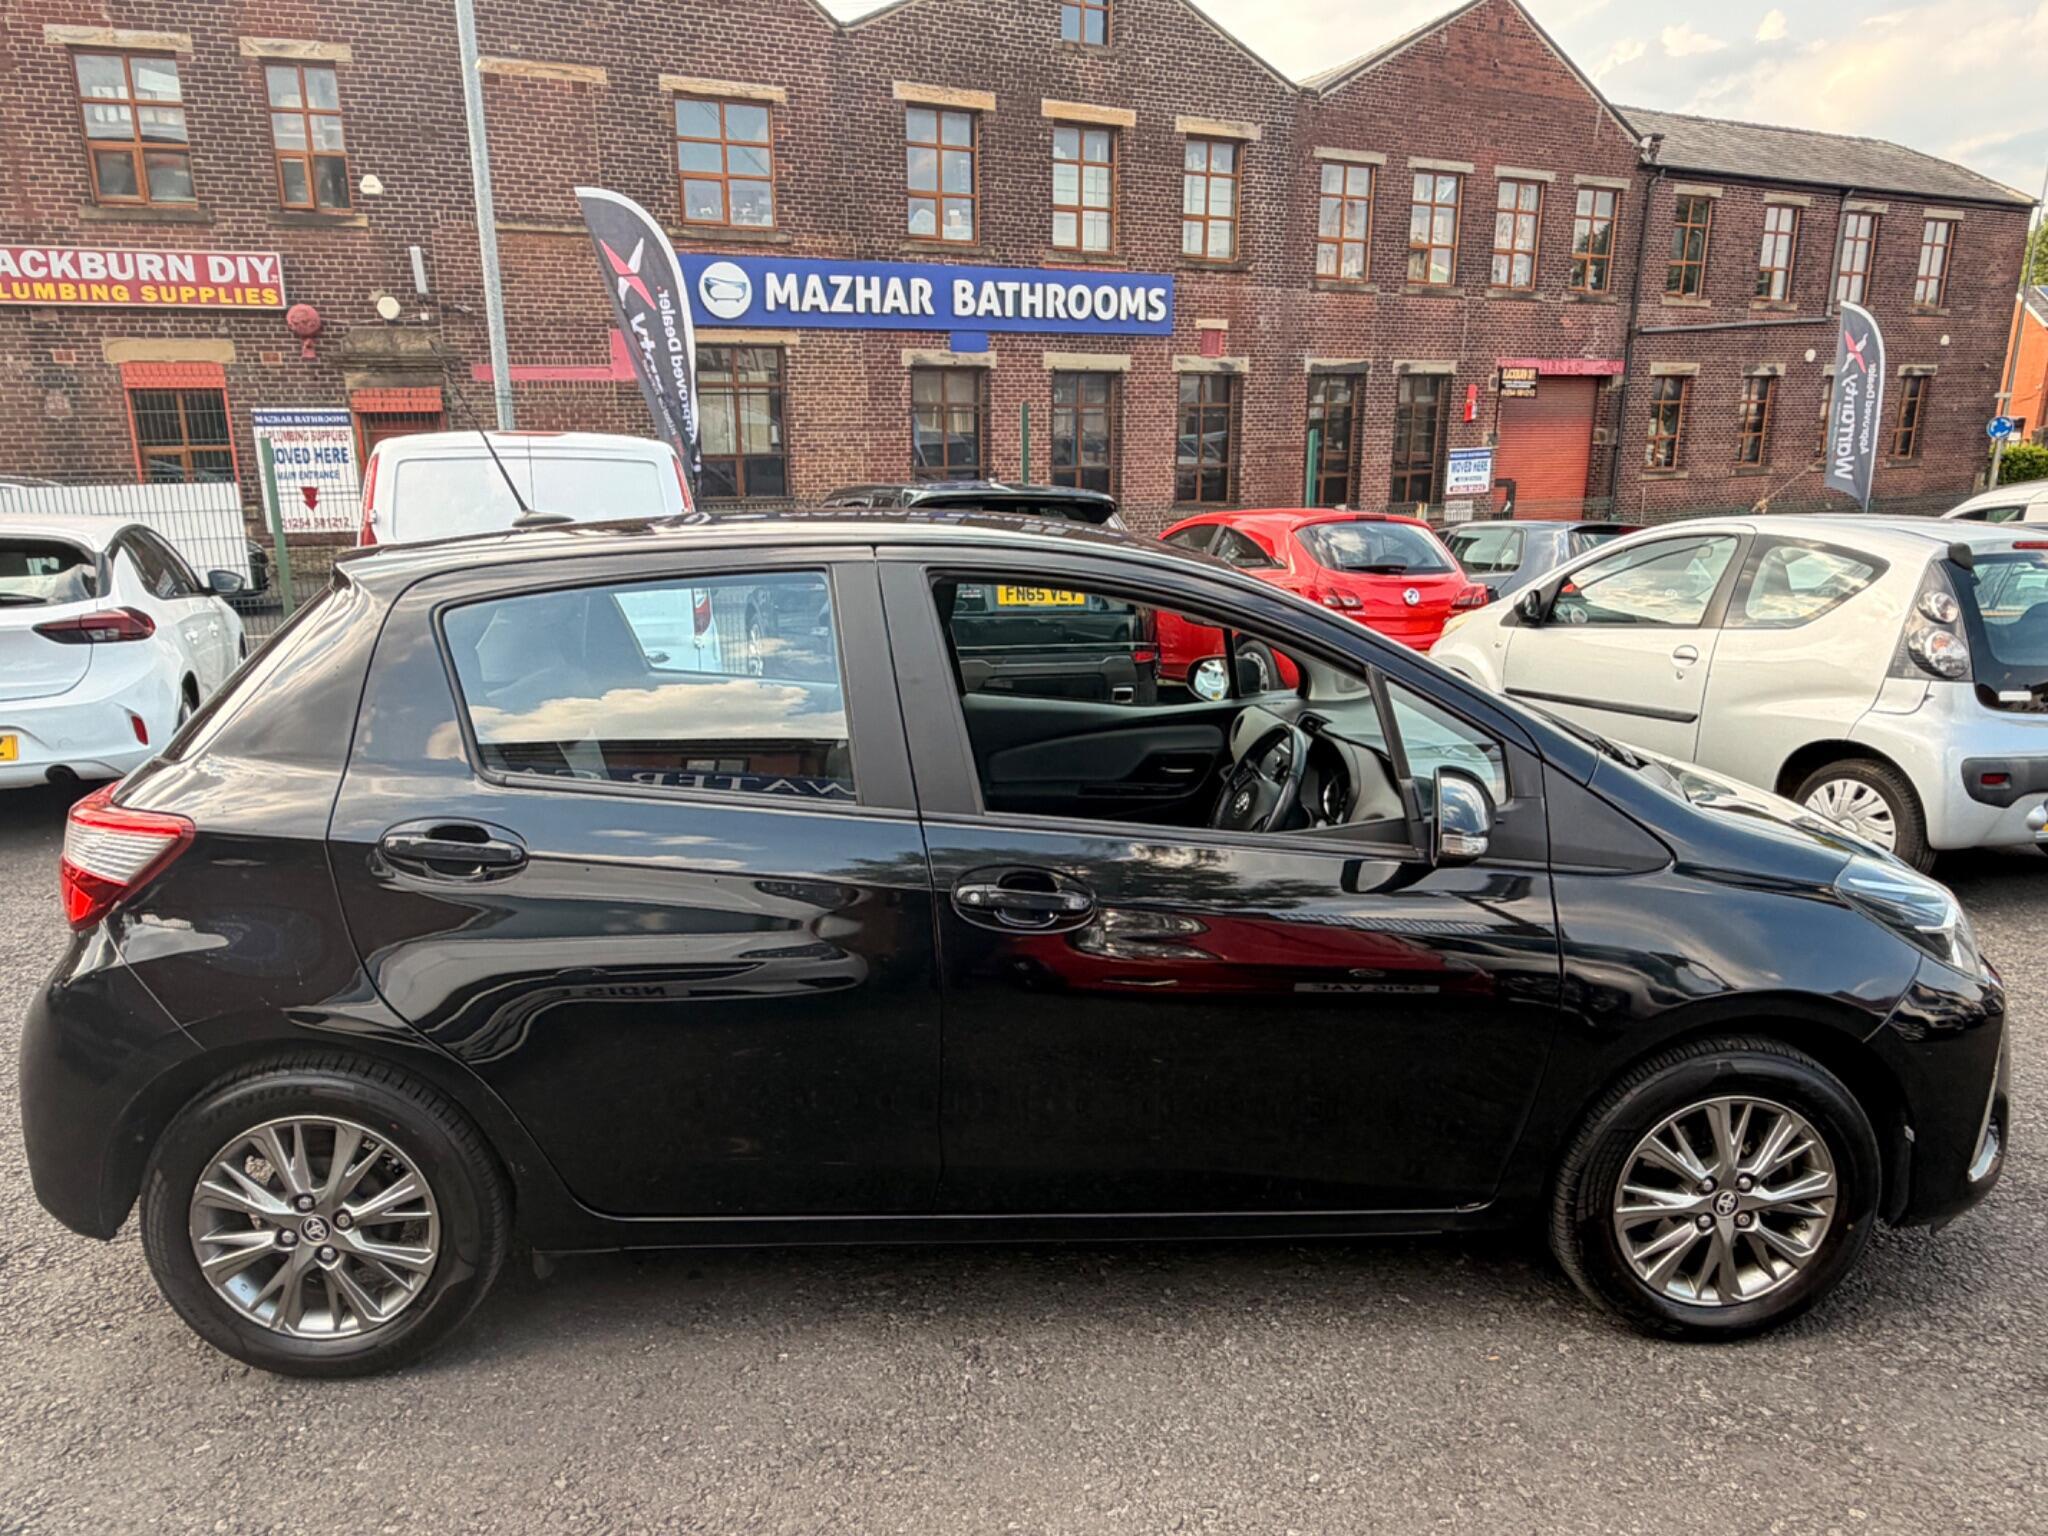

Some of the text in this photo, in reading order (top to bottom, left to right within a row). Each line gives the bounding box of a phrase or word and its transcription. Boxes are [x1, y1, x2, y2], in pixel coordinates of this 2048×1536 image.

[0, 250, 274, 283] ACKBURN DIY
[0, 282, 279, 305] LUMBING SUPPLIES
[765, 272, 1167, 322] MAZHAR BATHROOMS
[294, 415, 349, 423] BATHROOMS
[272, 447, 349, 464] OVED HERE
[299, 470, 341, 480] ENTRANCE
[1006, 586, 1045, 601] FN65
